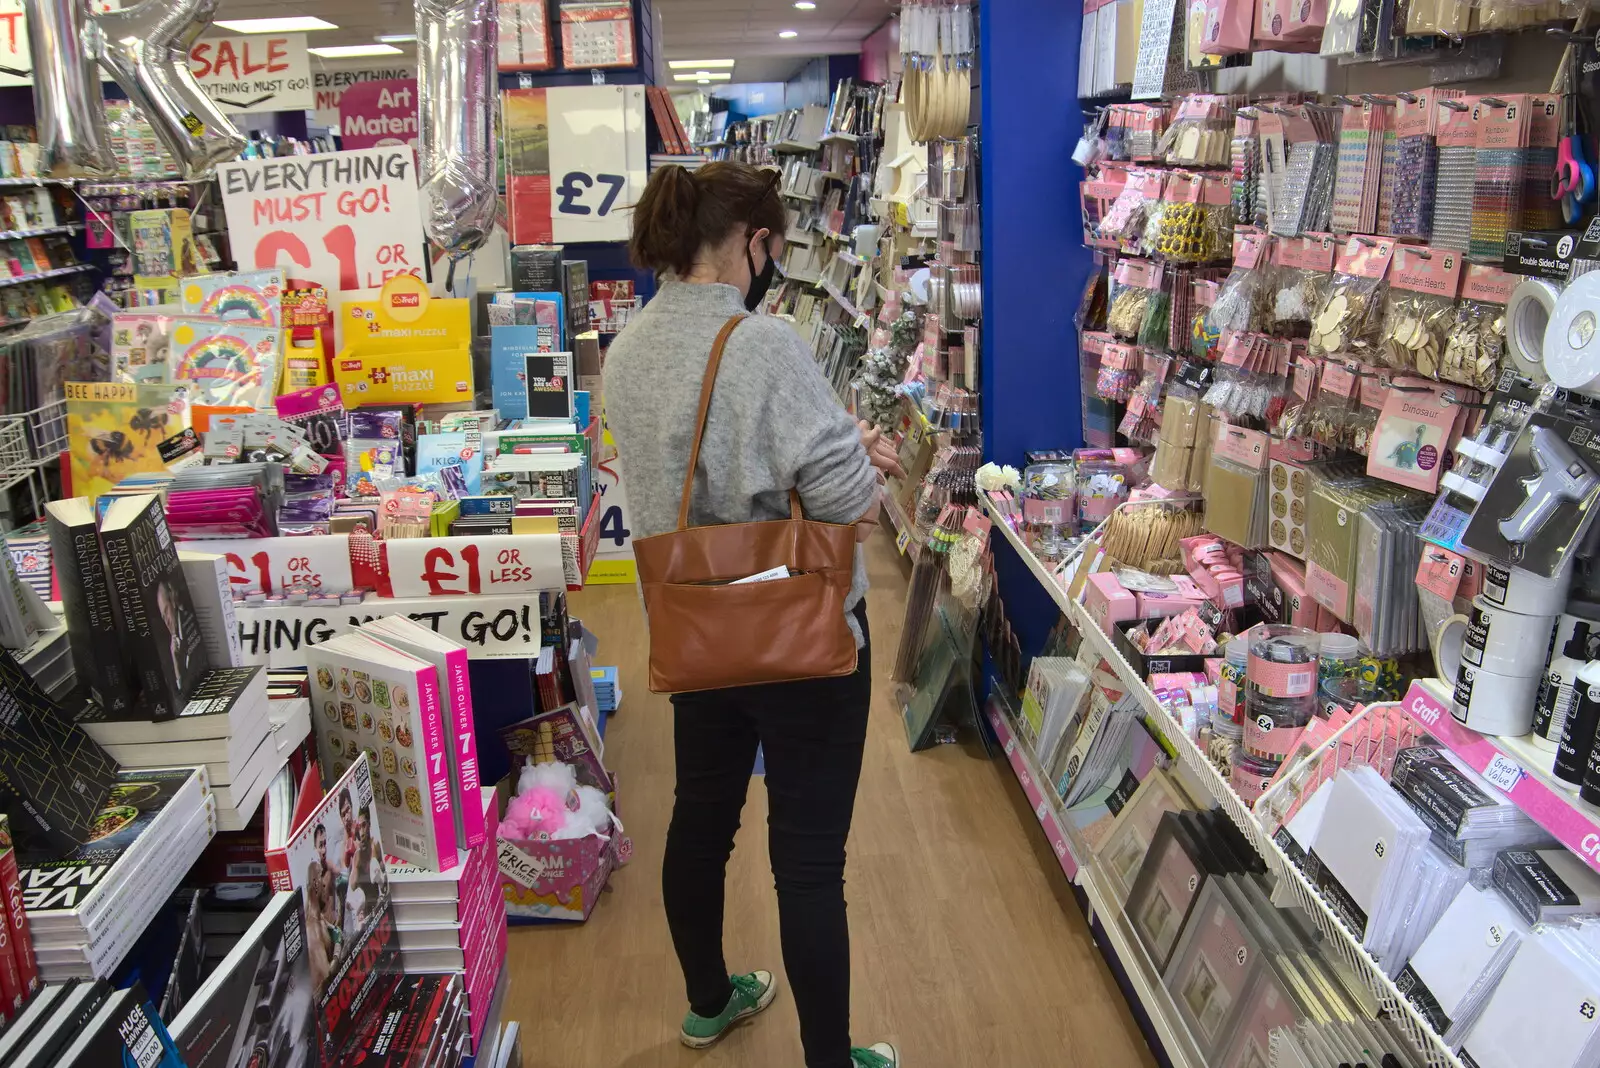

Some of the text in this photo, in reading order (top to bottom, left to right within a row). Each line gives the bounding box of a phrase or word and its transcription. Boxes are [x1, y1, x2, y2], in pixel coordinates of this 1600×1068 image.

[190, 38, 289, 80] SALE
[254, 79, 284, 93] MUST
[288, 77, 310, 90] GO!
[378, 86, 412, 109] Art
[1507, 107, 1517, 120] £1
[1545, 103, 1556, 117] £1
[345, 114, 417, 136] Materi
[226, 153, 409, 195] EVERYTHING
[556, 171, 625, 217] £7
[253, 184, 391, 226] MUST GO!
[376, 243, 409, 265] OR
[1558, 243, 1570, 256] £1
[1520, 256, 1570, 271] Double Sided Tape
[1424, 276, 1446, 290] Hearts
[1470, 282, 1495, 294] Wooden
[381, 328, 447, 337] maxi PUZZLE
[391, 369, 434, 382] maxi
[67, 384, 135, 400] BEE HAPPY
[393, 382, 435, 392] PUZZLE
[1401, 402, 1438, 419] Dinosaur
[1508, 399, 1520, 409] LED
[499, 501, 510, 509] £5
[600, 505, 631, 547] 4
[74, 534, 95, 589] CENTURY
[287, 557, 312, 572] OR
[496, 549, 523, 565] OR
[106, 540, 129, 597] CENTURY
[420, 544, 481, 596] £1
[490, 566, 533, 583] LESS
[1450, 564, 1459, 576] £1
[1494, 569, 1508, 581] Tape
[85, 533, 114, 632] PRINCE PHILIP'S
[117, 538, 150, 637] PRINCE PHILIP'S
[281, 574, 322, 589] LESS
[216, 568, 237, 629] TRACES
[1260, 592, 1279, 619] Twine
[460, 605, 532, 646] GO!
[1482, 614, 1490, 623] £1
[1471, 631, 1485, 643] Tape
[1551, 673, 1562, 683] £2
[1411, 697, 1440, 726] Craft
[455, 664, 478, 791] JAMIE OLIVER 7 WAYS
[1258, 718, 1271, 731] £4
[424, 682, 449, 813] JAMIE OLIVER 7 WAYS
[1561, 742, 1576, 755] Glue
[1494, 757, 1518, 775] Great
[1488, 768, 1510, 786] Value
[1430, 766, 1447, 783] Cards
[1449, 782, 1478, 807] Envelopes
[22, 799, 51, 832] WENDY HOBSON
[1413, 784, 1428, 800] Cards
[1431, 802, 1457, 831] Envelopes
[1055, 839, 1066, 858] Craft
[1374, 842, 1385, 858] £3
[39, 859, 88, 868] MANUAL
[499, 849, 540, 879] PRICE
[18, 864, 107, 888] MA
[512, 869, 533, 884] LINES!
[8, 880, 24, 929] Keto
[1489, 925, 1501, 943] £3.50
[325, 912, 392, 1033] BOXING
[327, 958, 353, 997] ULTIMATE
[1580, 1001, 1596, 1019] £3
[118, 1003, 145, 1040] HUGE
[125, 1016, 149, 1048] SAVINGS
[140, 1041, 159, 1068] £10.00
